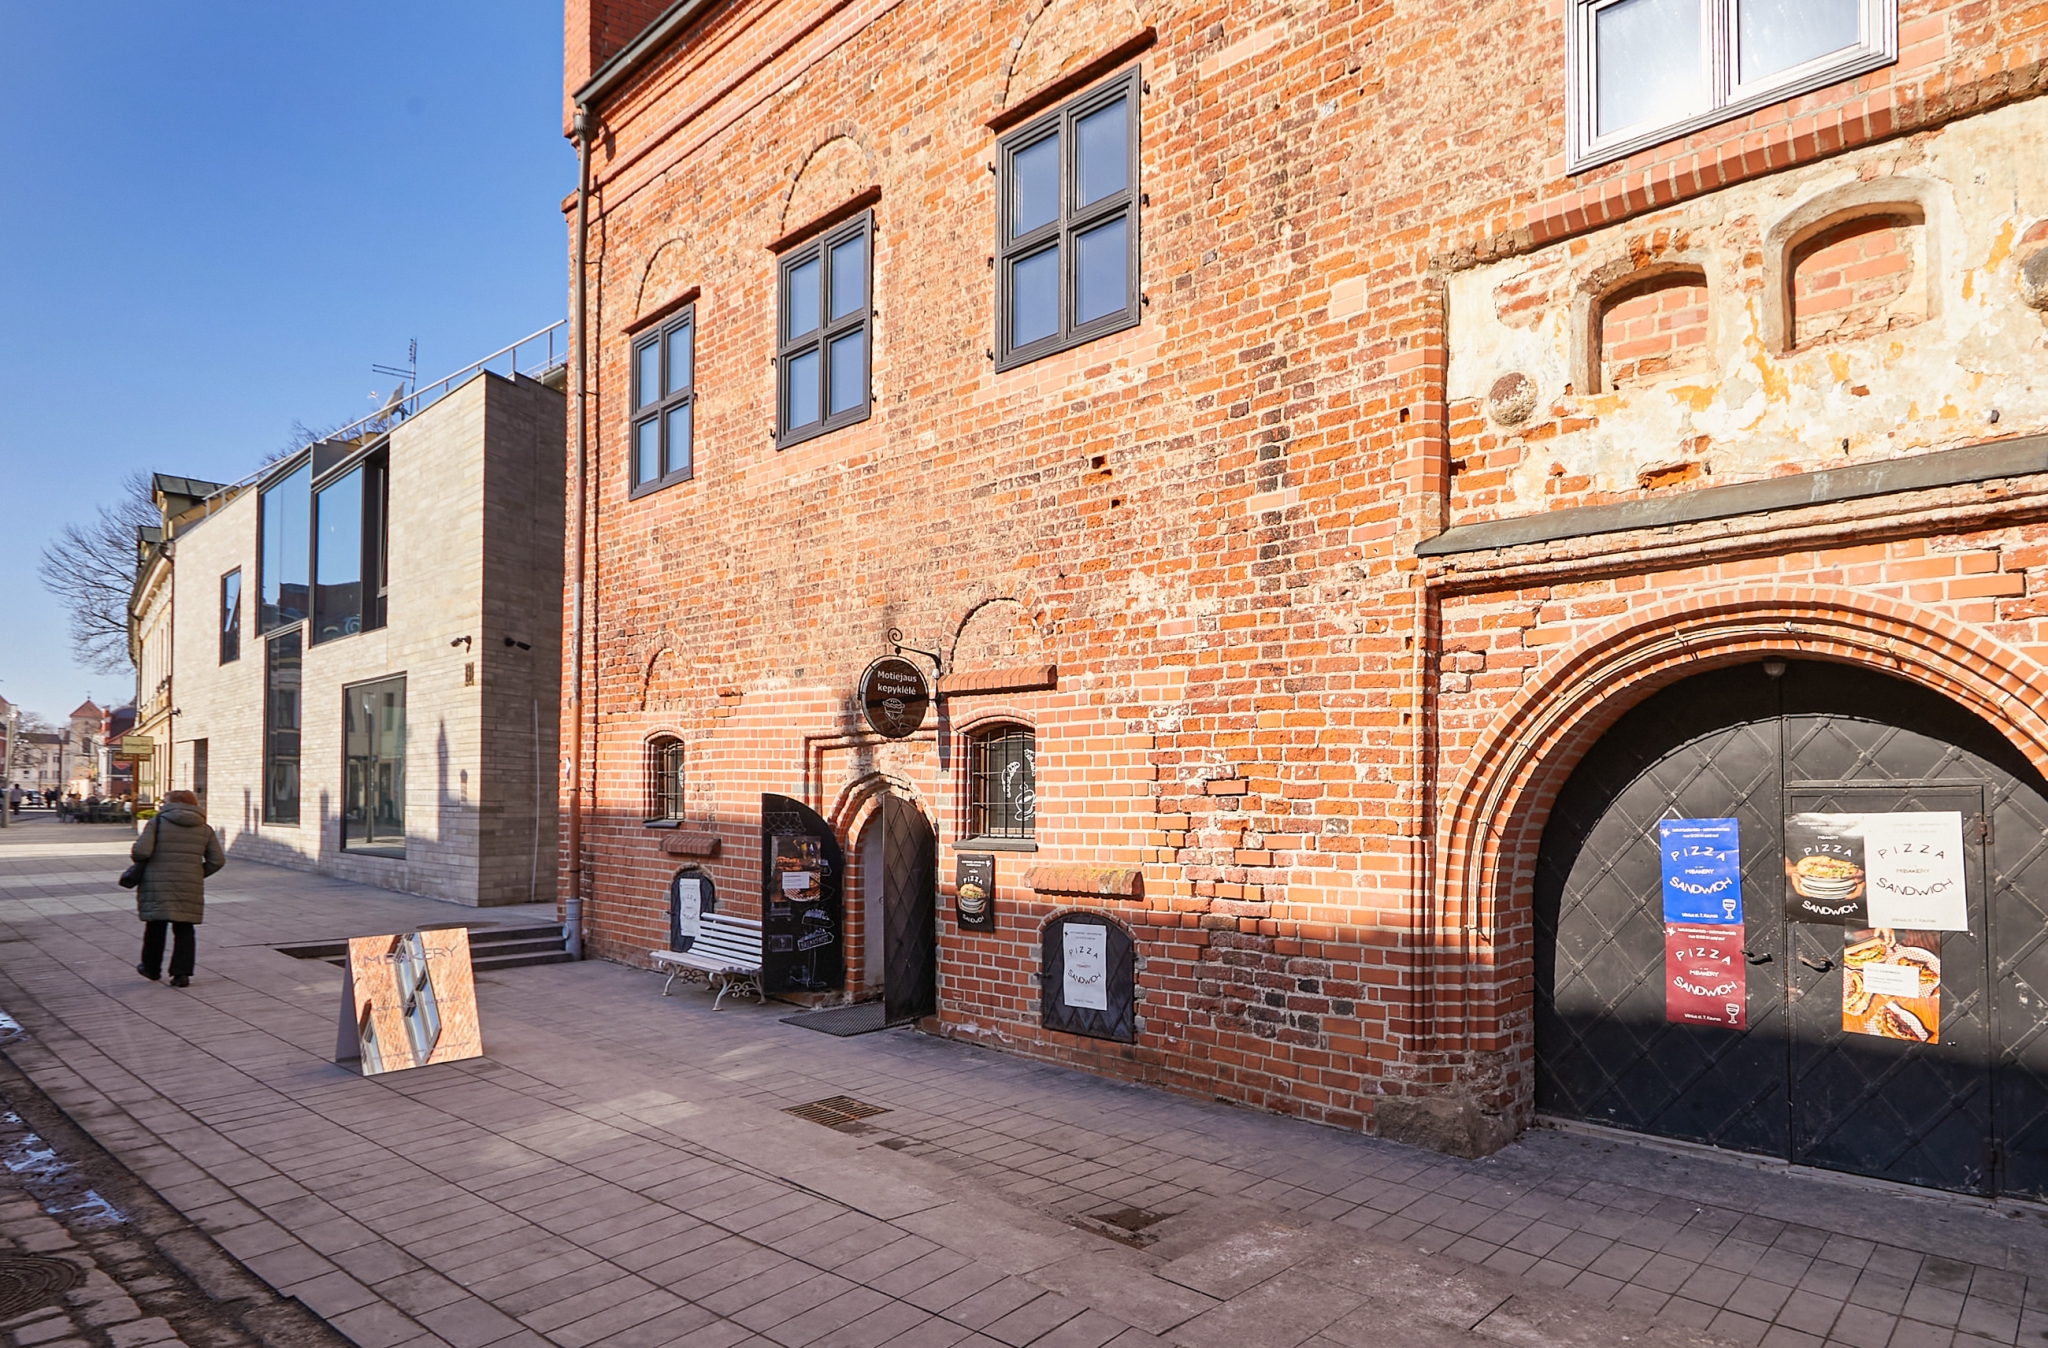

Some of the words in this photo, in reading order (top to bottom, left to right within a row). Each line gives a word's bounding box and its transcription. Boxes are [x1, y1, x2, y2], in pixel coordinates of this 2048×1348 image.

[877, 670, 918, 682] Motiejaus
[877, 683, 916, 696] kepyklėlė
[1670, 846, 1726, 862] PIZZA
[1804, 844, 1852, 857] PIZZA
[1878, 843, 1944, 859] PIZZA
[963, 876, 983, 885] PIZZA
[1669, 876, 1732, 894] SANDWICH
[1876, 878, 1954, 896] SANDWICH
[1802, 900, 1858, 915] SANDWICH
[1069, 946, 1098, 959] PIZZA
[1675, 947, 1731, 965] PIZZA
[1068, 969, 1101, 984] SANDWICH
[1673, 976, 1738, 997] SANDWICH
